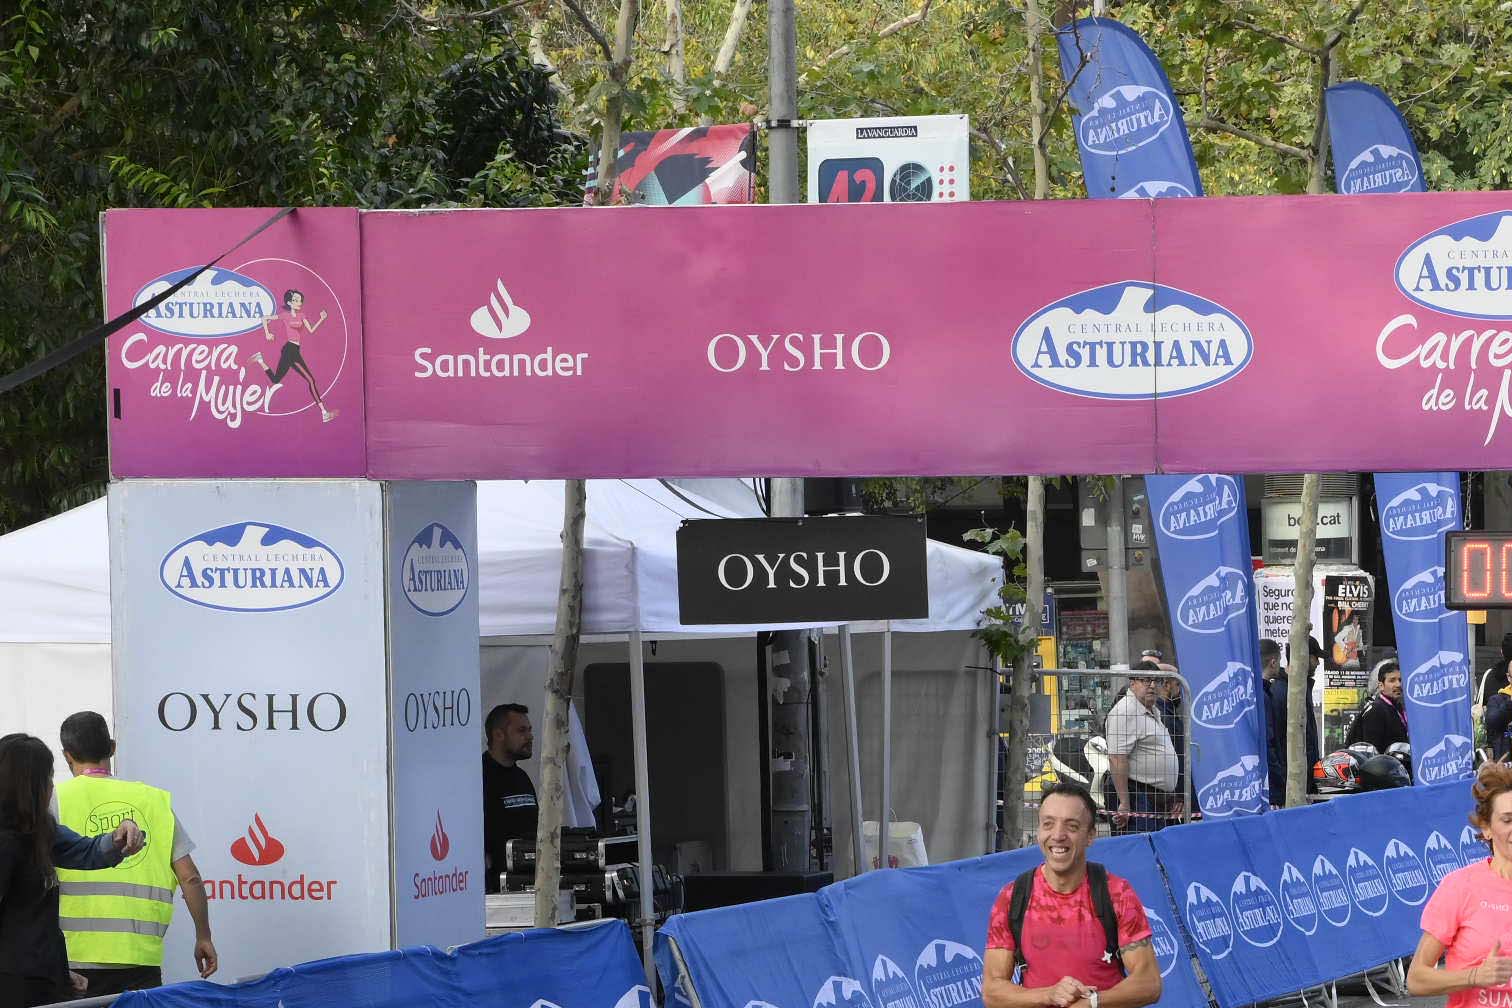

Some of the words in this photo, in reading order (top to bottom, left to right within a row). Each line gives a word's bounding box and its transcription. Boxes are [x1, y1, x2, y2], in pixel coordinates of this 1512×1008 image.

[145, 293, 264, 320] ASTURIANA
[172, 291, 211, 299] ENTRAL
[215, 291, 260, 299] LECHERA
[1067, 321, 1141, 334] CENTRAL
[1153, 320, 1226, 333] LECHERA
[121, 333, 237, 370] Carrera
[414, 347, 588, 377] Santander
[707, 331, 890, 372] OYSHO
[1031, 326, 1233, 368] ASTURIANA
[150, 376, 172, 398] de
[176, 375, 193, 398] la
[189, 368, 283, 428] Mujer
[1422, 373, 1456, 412] de
[1464, 373, 1489, 411] la
[175, 555, 331, 590] ASTURIANA
[203, 553, 261, 562] CENTRAL
[265, 552, 325, 562] LECHERA
[717, 549, 890, 591] OYSHO
[407, 558, 465, 593] ASTURIANA
[1338, 584, 1368, 598] ELVIS
[1263, 601, 1280, 612] que
[157, 692, 347, 733] OYSHO
[404, 687, 471, 733] OYSHO
[183, 874, 338, 901] antander
[413, 867, 470, 900] Santander
